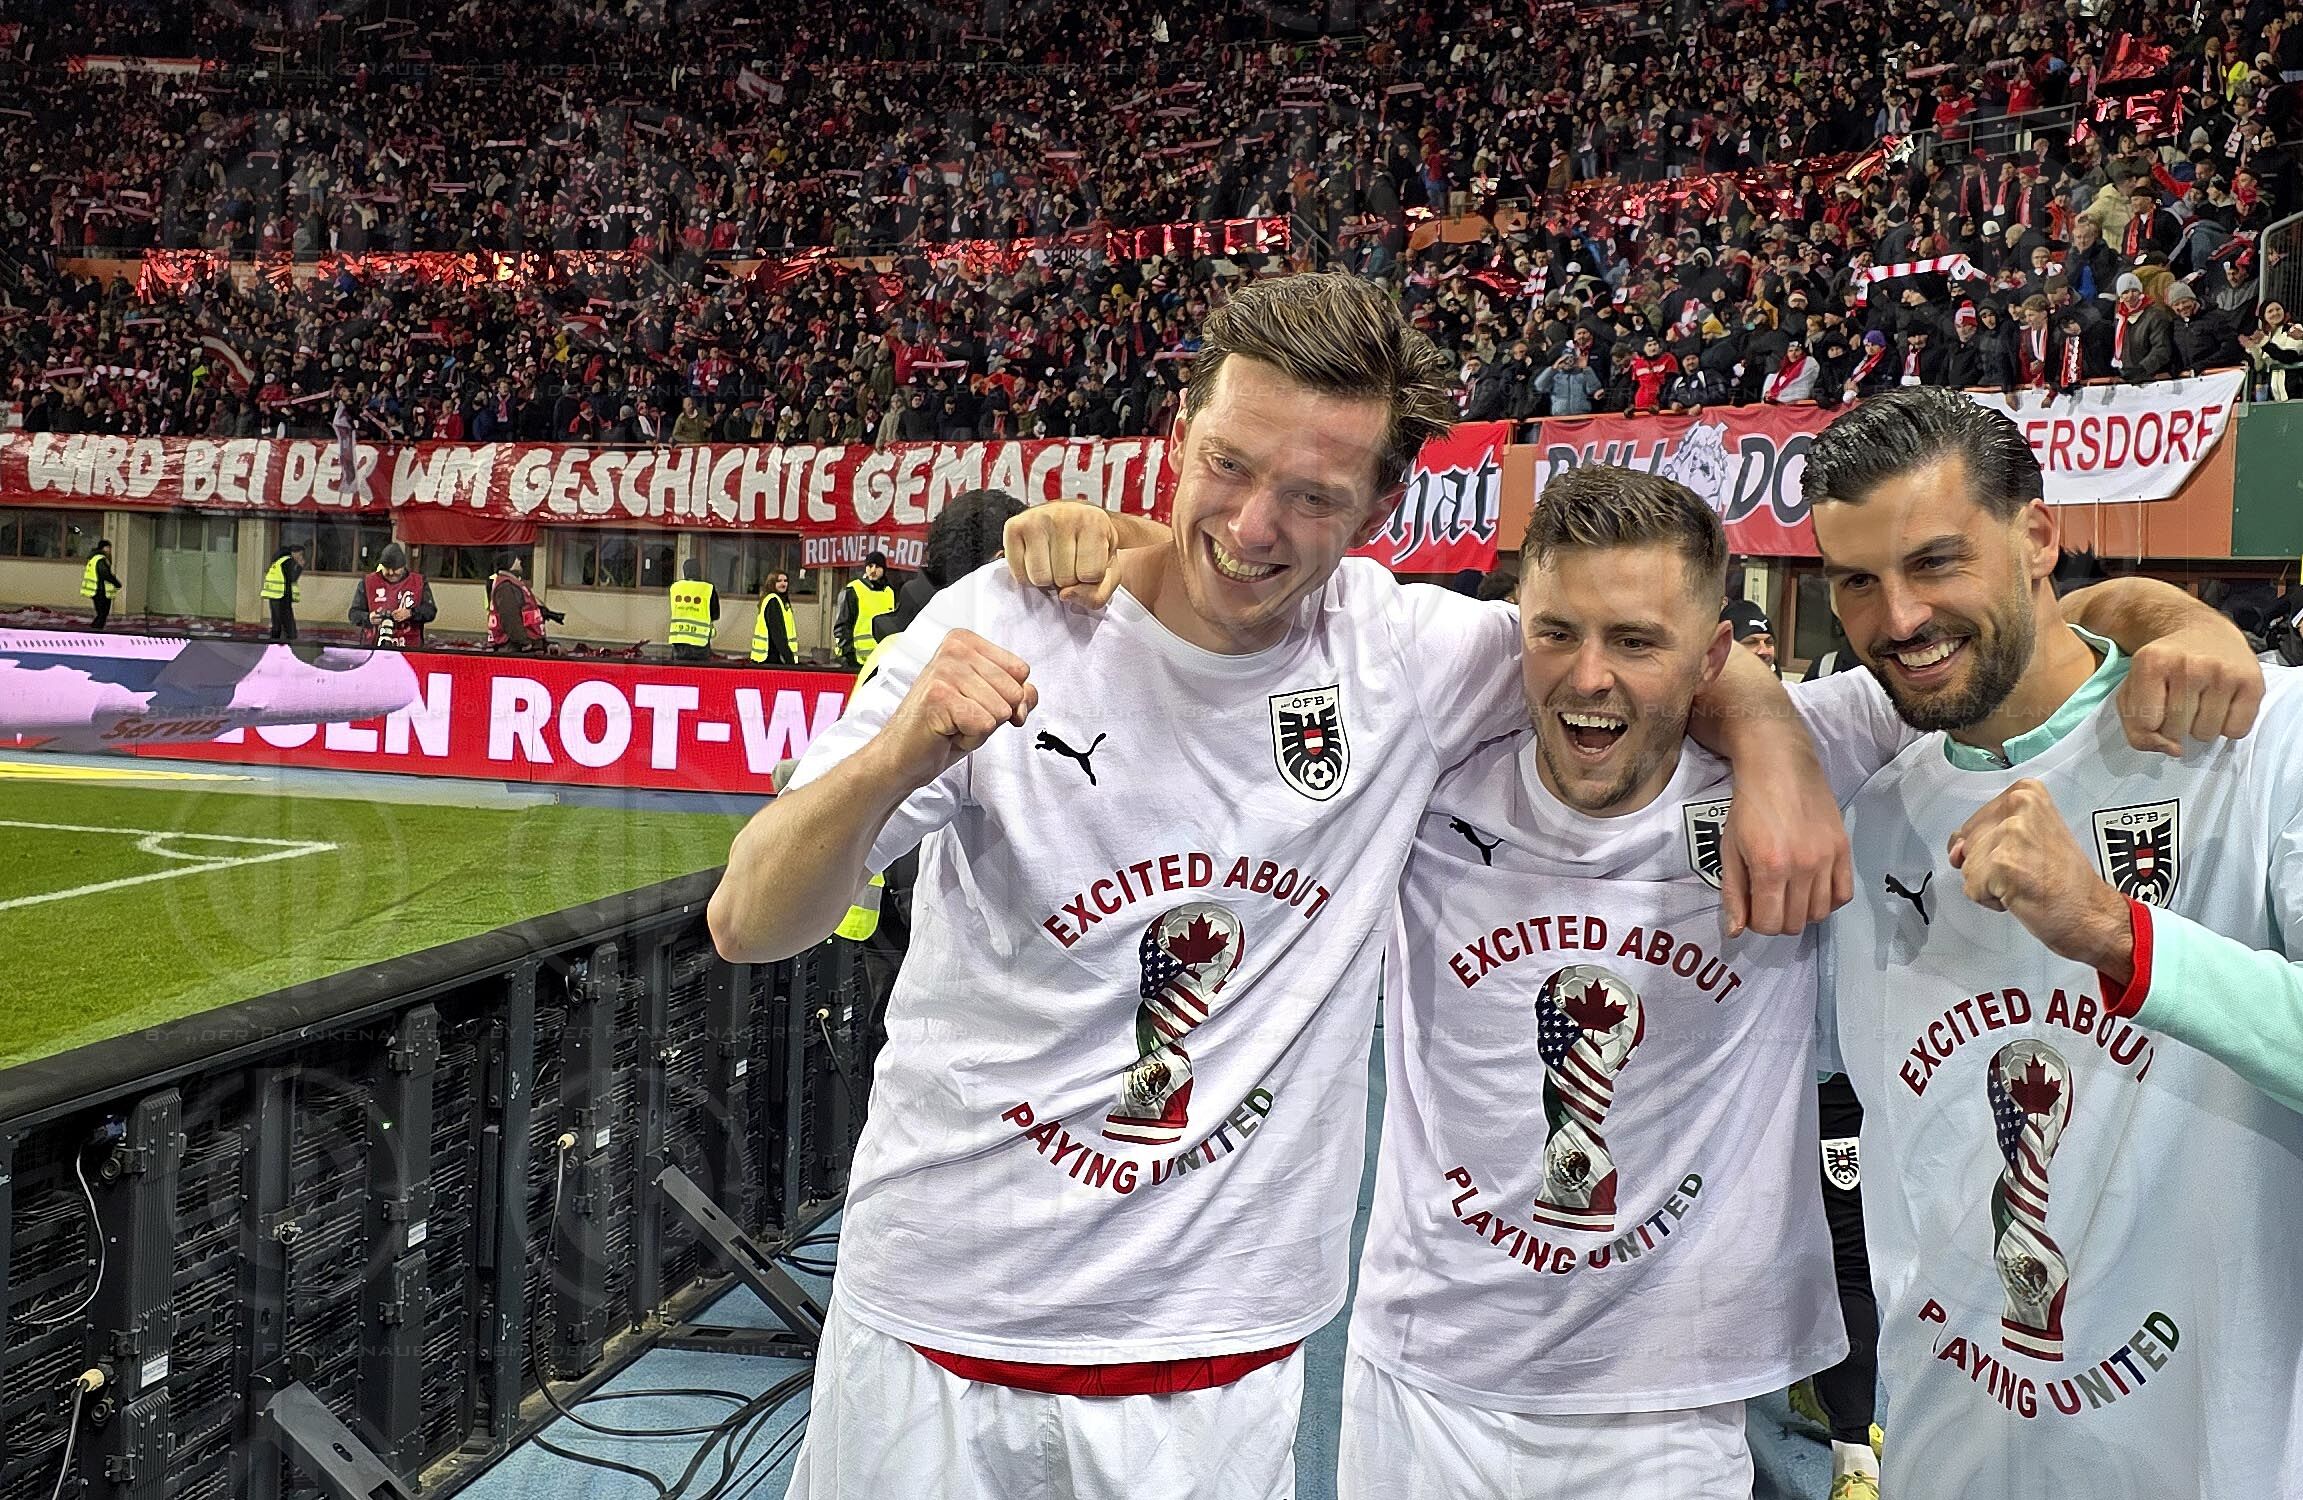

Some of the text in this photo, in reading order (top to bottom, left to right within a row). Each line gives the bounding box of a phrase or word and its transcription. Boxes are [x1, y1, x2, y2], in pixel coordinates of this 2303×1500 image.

[28, 432, 164, 497] WIRD
[181, 439, 271, 504] BEI
[281, 441, 379, 508] DER
[391, 443, 499, 509] WM
[508, 445, 845, 522] GESCHICHTE
[2025, 405, 2223, 471] ERSDORF
[101, 717, 232, 739] Servus
[488, 676, 845, 775] ROT-W
[1292, 696, 1324, 708] ÖFB
[1708, 806, 1731, 817] ÖF
[2121, 812, 2158, 825] ÖFB
[1042, 853, 1330, 949] EXCITED ABOUT
[1448, 916, 1742, 1004] EXCITED ABOUT
[1899, 987, 2032, 1097] EXCITED
[1151, 1087, 1273, 1186] UNITED
[1444, 1166, 1703, 1274] PLAYING UNITED
[1918, 1298, 2181, 1419] PAYING UNITED
